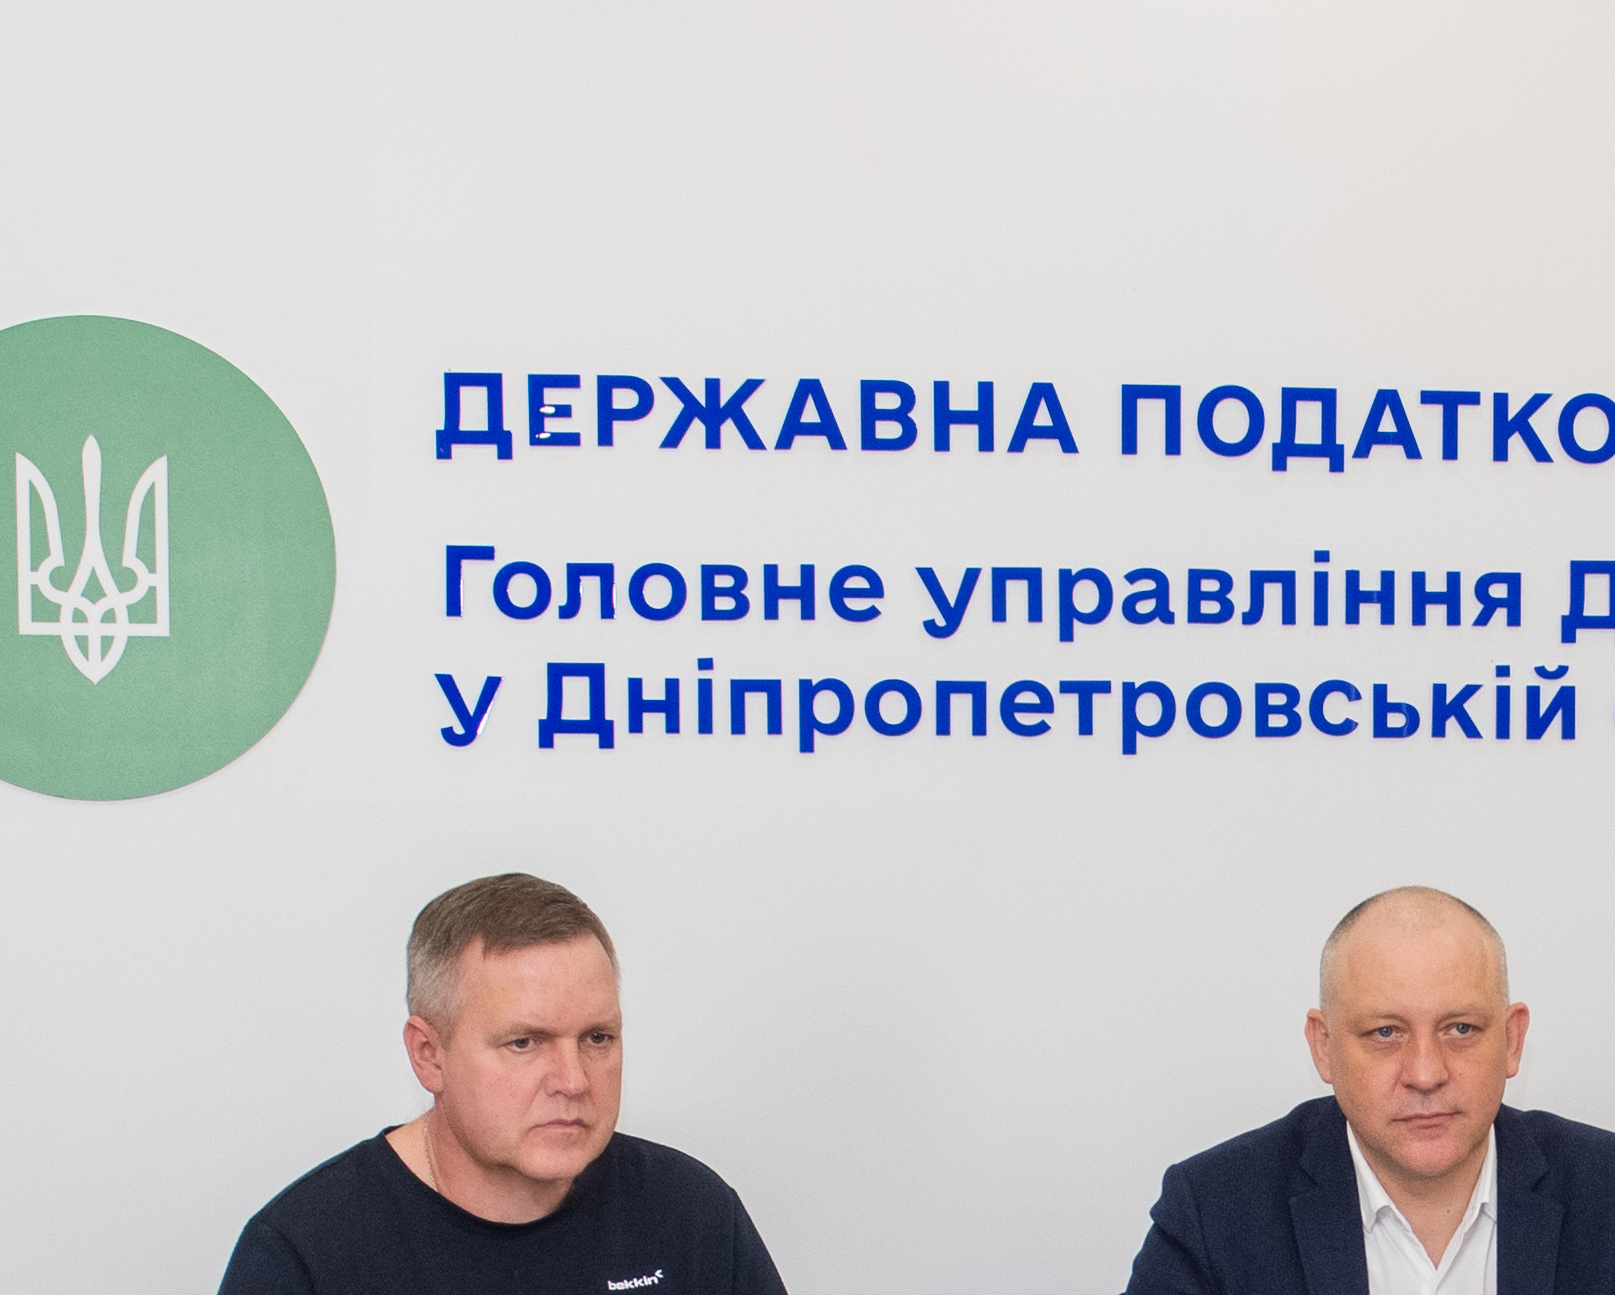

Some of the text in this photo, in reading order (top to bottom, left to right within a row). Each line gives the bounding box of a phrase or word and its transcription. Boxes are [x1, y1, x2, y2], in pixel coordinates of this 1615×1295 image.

[435, 371, 1078, 460] ДЕРЖАВНА
[442, 545, 884, 622] Головне
[915, 550, 1523, 642] управління
[434, 673, 503, 747] у
[537, 657, 1576, 755] Дніпропетровській
